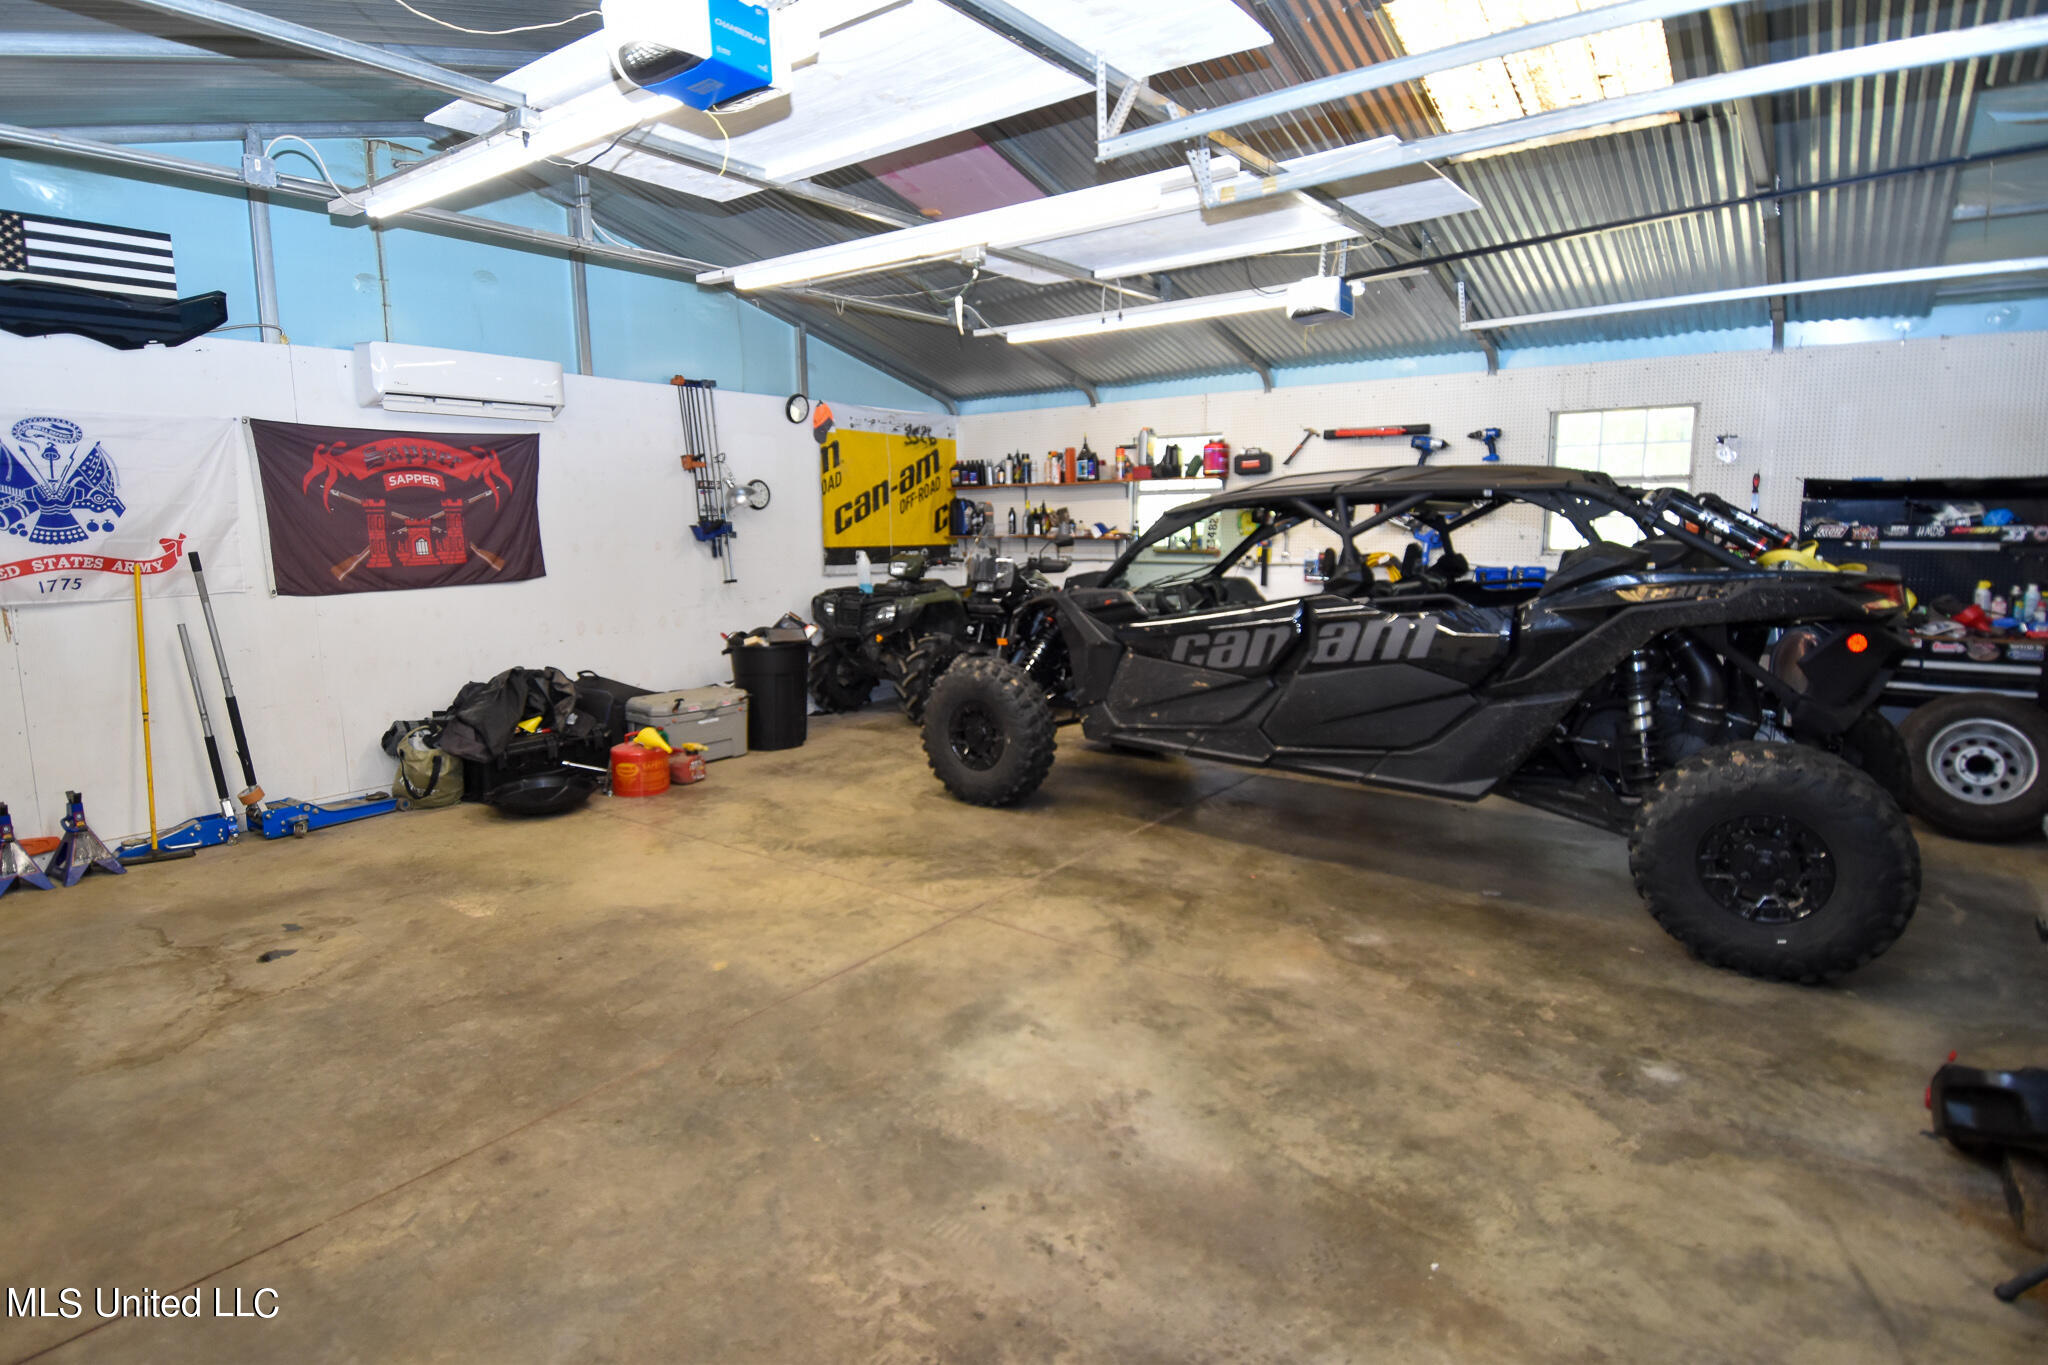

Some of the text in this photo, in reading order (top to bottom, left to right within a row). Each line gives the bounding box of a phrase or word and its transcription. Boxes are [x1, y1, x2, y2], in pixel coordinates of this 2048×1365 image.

[714, 17, 767, 46] CHAMBERLAIN
[388, 474, 440, 487] SAPPER
[900, 476, 941, 514] OFF-ROAD
[31, 556, 104, 573] STATES
[111, 559, 164, 573] ARMY
[38, 577, 83, 594] 1775
[1172, 615, 1441, 669] can am
